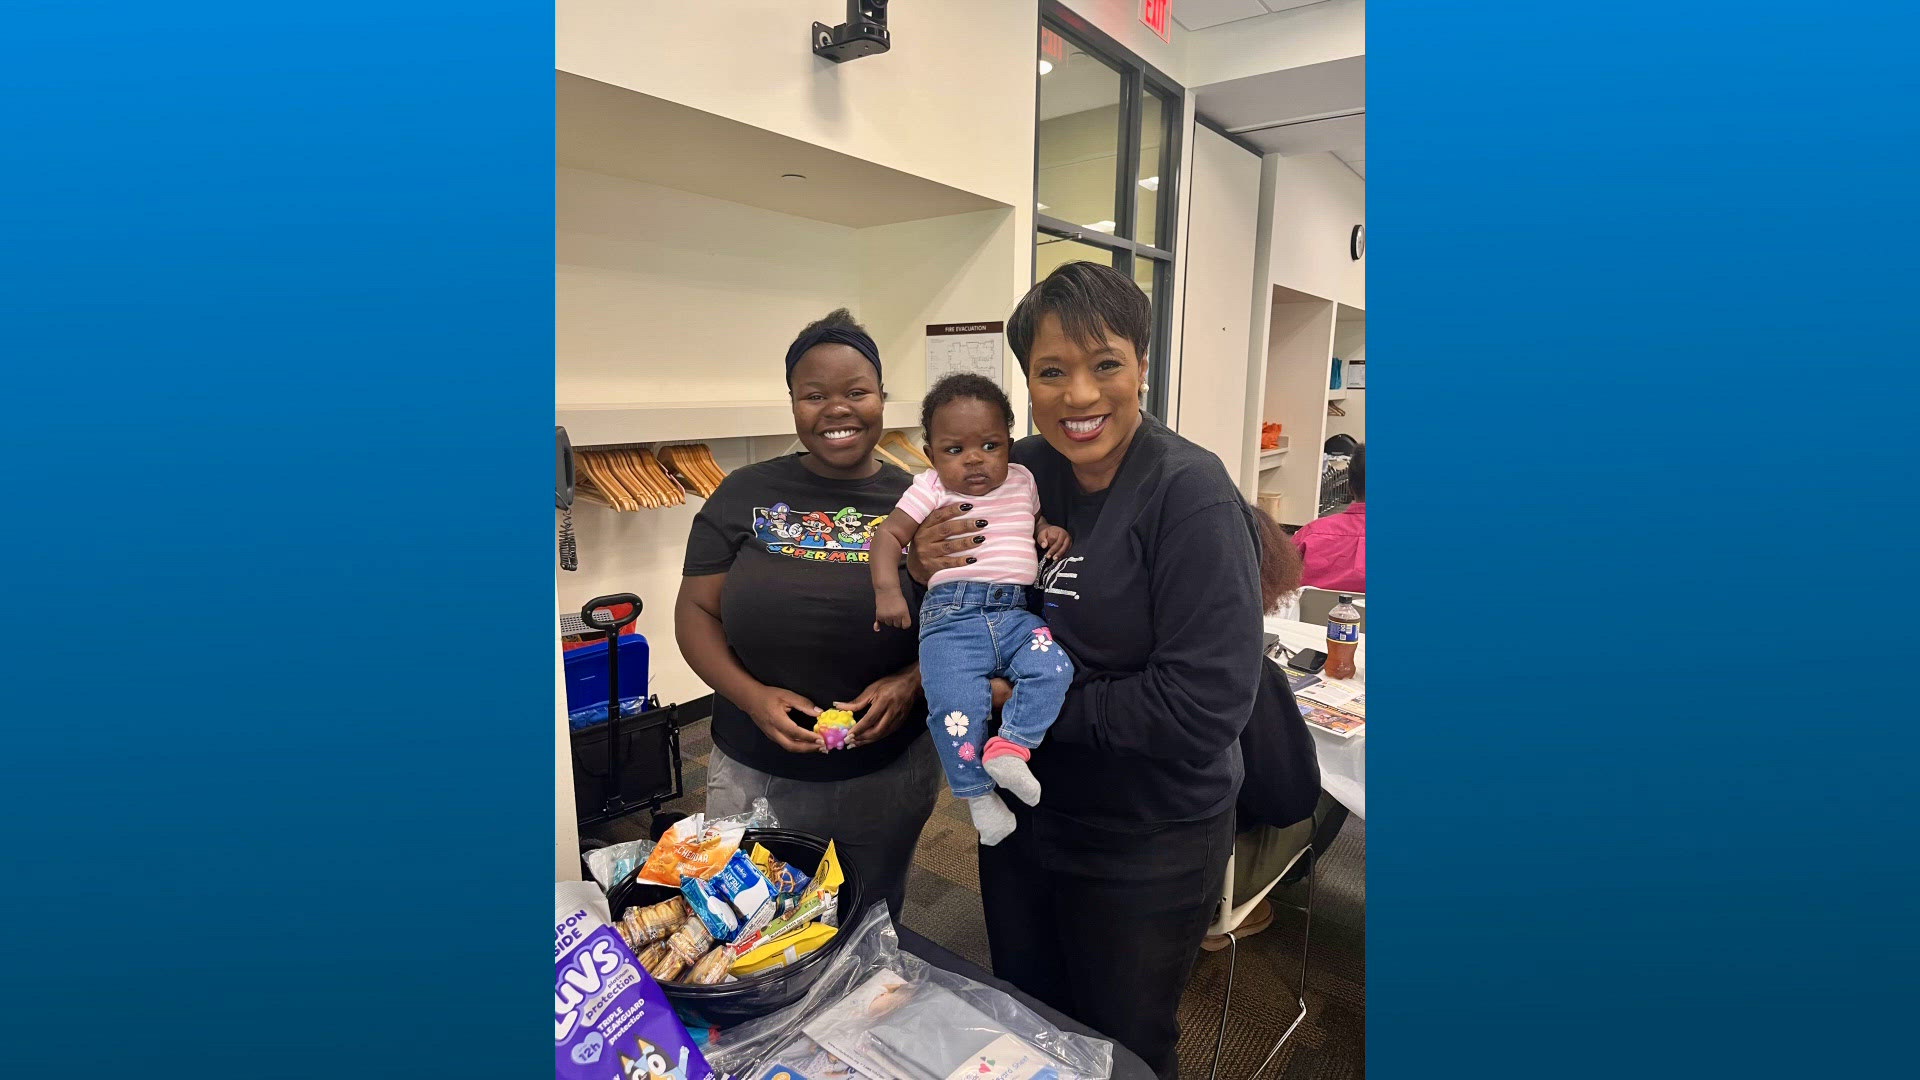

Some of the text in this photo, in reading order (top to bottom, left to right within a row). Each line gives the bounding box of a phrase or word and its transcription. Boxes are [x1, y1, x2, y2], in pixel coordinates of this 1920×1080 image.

[828, 551, 869, 563] MAR
[677, 846, 709, 863] CHEDDAR
[586, 974, 635, 1020] protection
[597, 1006, 624, 1031] TRIPLE
[603, 998, 645, 1038] LEAKGUARD
[609, 1010, 645, 1046] protection
[578, 1042, 601, 1061] 12h
